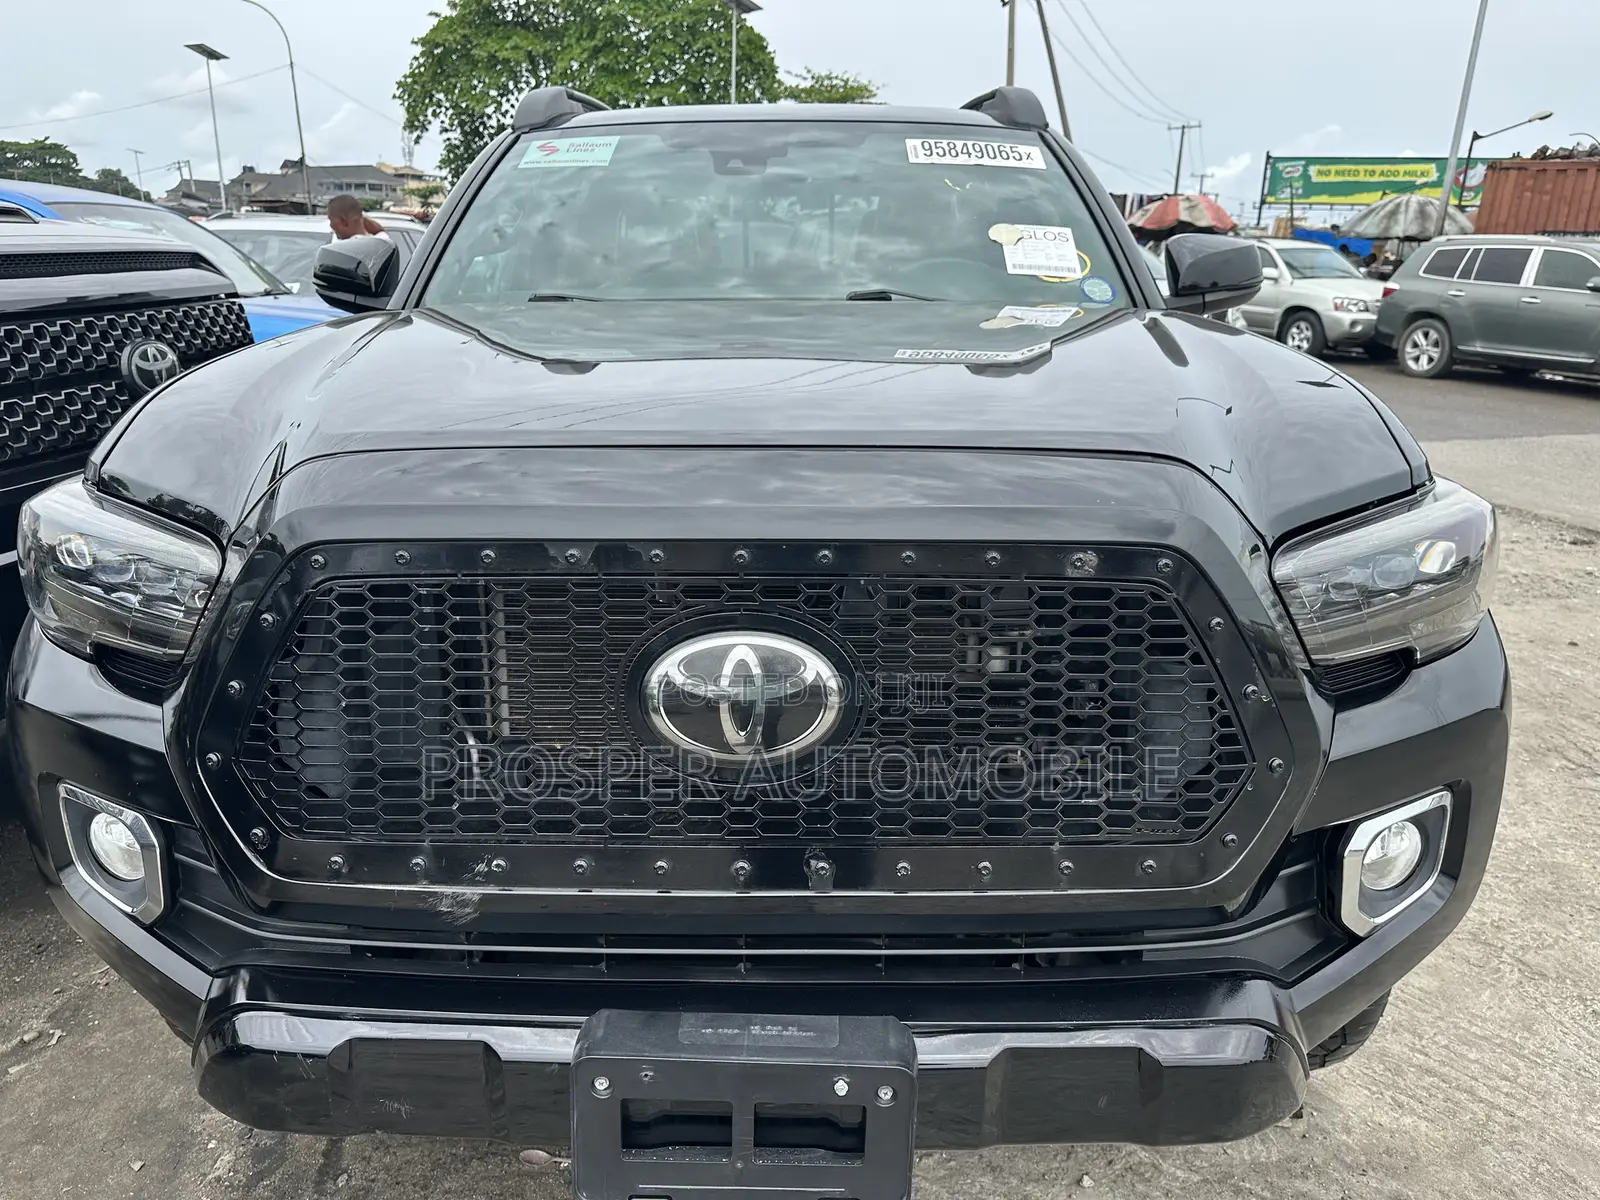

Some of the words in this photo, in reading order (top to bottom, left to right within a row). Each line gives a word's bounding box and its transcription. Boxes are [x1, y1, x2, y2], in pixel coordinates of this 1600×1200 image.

[1316, 168, 1332, 177] NO
[1334, 168, 1360, 177] NEED
[1363, 168, 1377, 177] TO
[1378, 168, 1400, 177] ADD
[1402, 168, 1430, 178] MILK!
